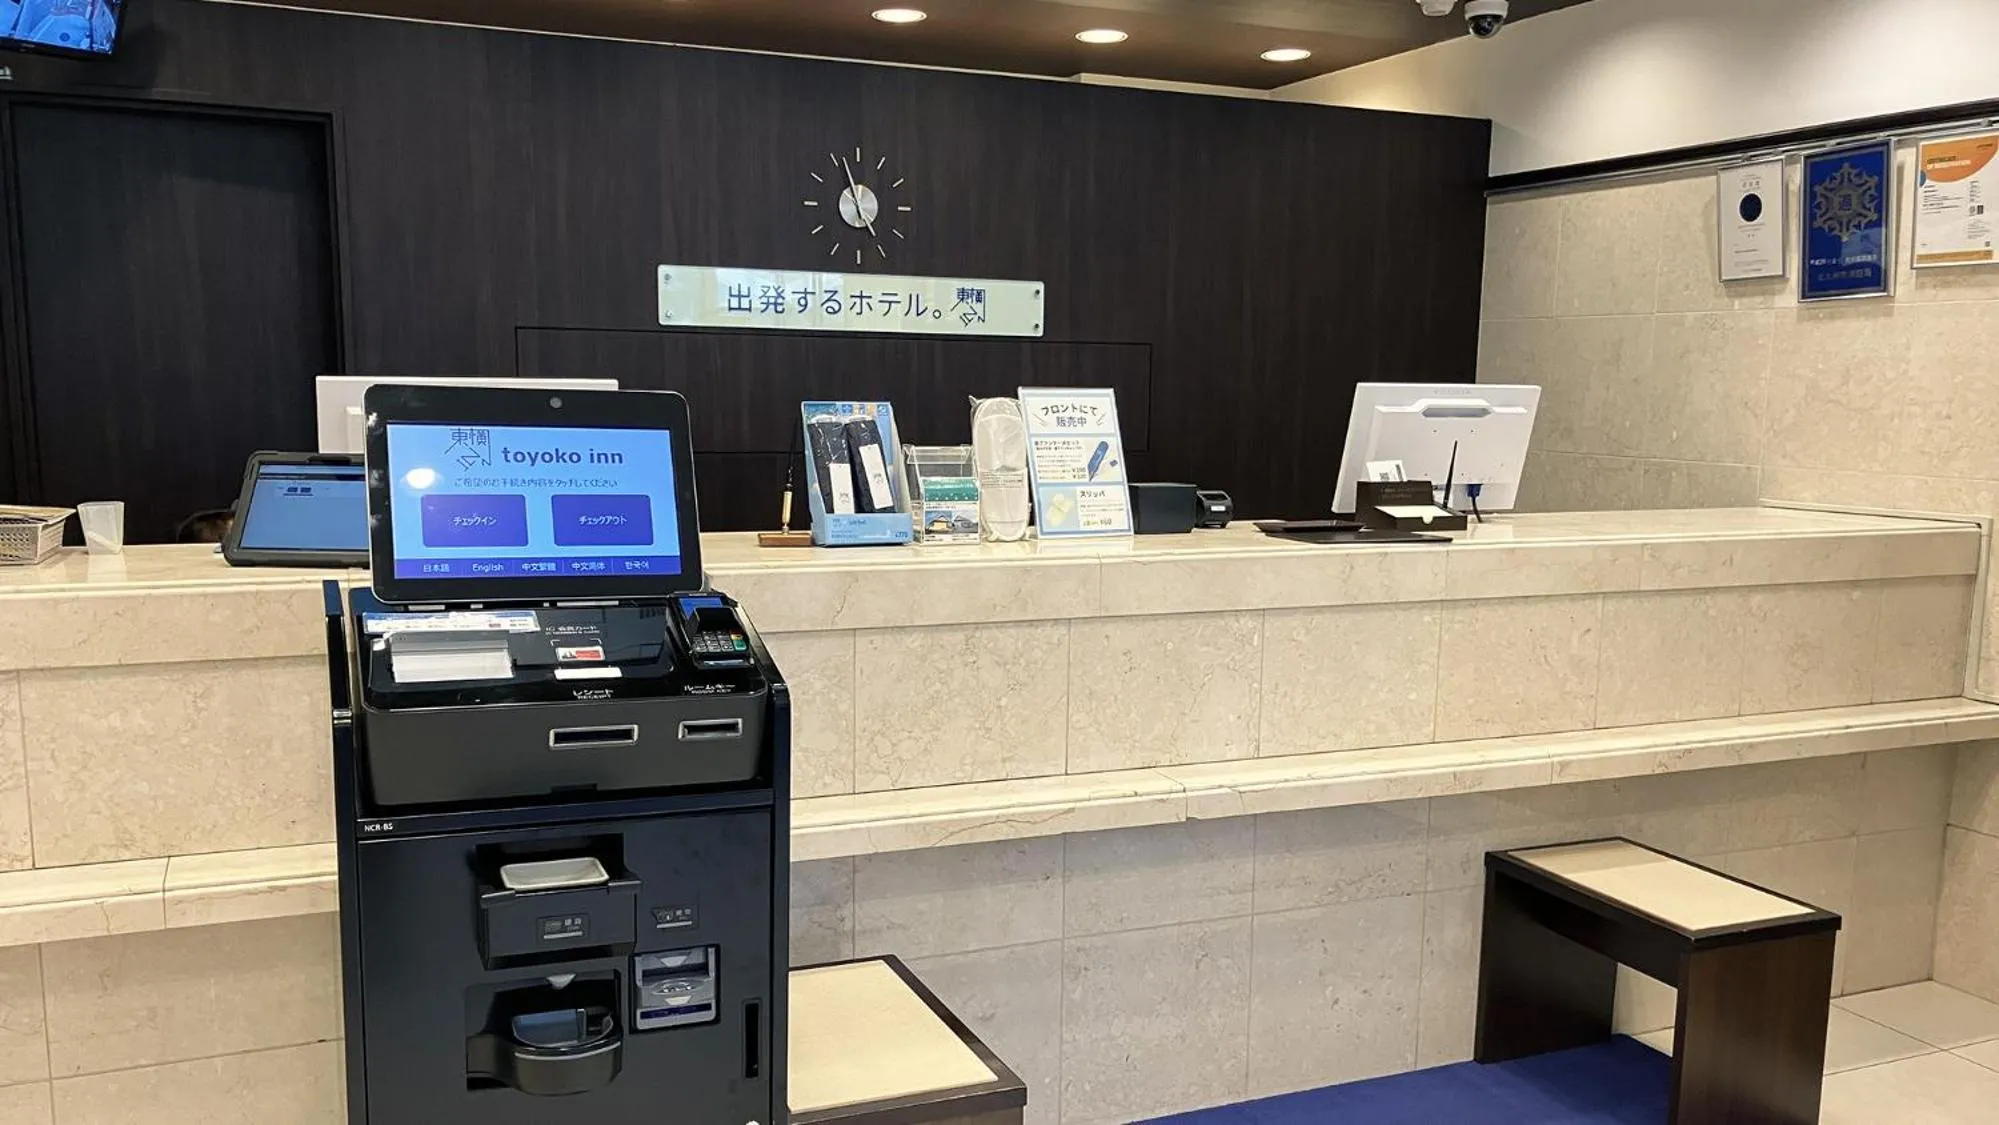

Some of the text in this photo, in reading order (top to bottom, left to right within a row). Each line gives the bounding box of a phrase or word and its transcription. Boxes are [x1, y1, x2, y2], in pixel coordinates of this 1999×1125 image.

[727, 284, 942, 321] 出発するホテル。
[1041, 403, 1098, 417] フロントにて
[1056, 416, 1087, 428] 販売中
[502, 447, 624, 467] toyoko inn
[453, 515, 497, 527] チェックイン
[579, 515, 628, 526] チェックアウト
[423, 563, 450, 573] 日本語
[472, 563, 504, 573] English
[624, 560, 650, 570] 한국어
